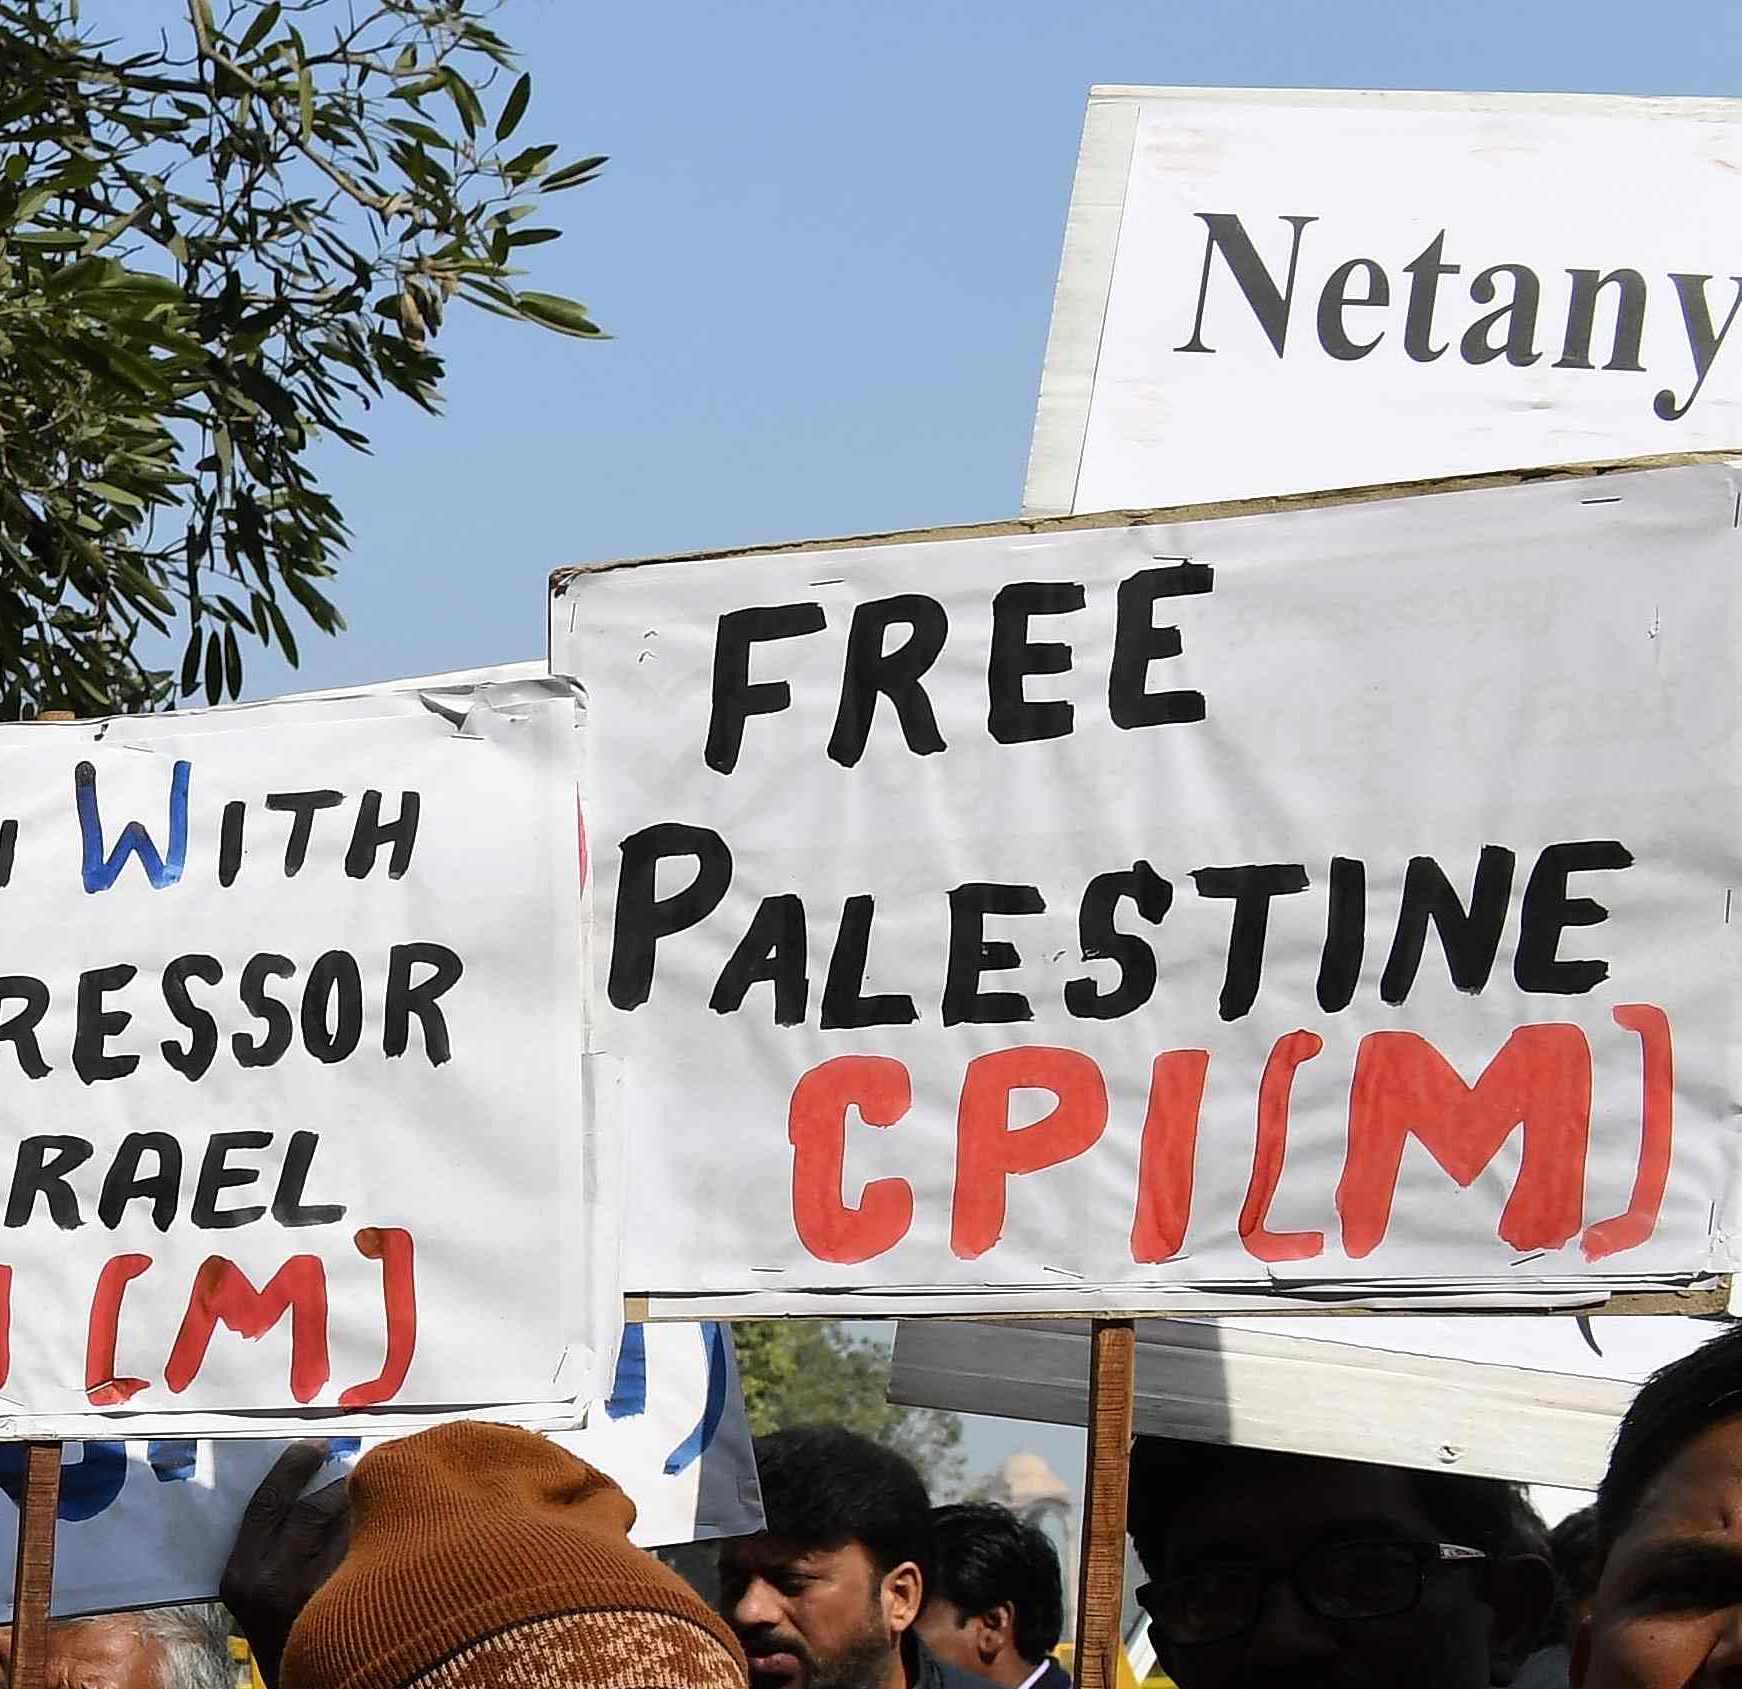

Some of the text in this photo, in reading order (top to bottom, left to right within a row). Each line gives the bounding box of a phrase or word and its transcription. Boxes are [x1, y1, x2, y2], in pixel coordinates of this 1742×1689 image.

[1172, 211, 1742, 421] Netany
[703, 560, 1216, 777] FREE
[74, 759, 422, 895] WITH
[605, 822, 1637, 1031] PALESTINE
